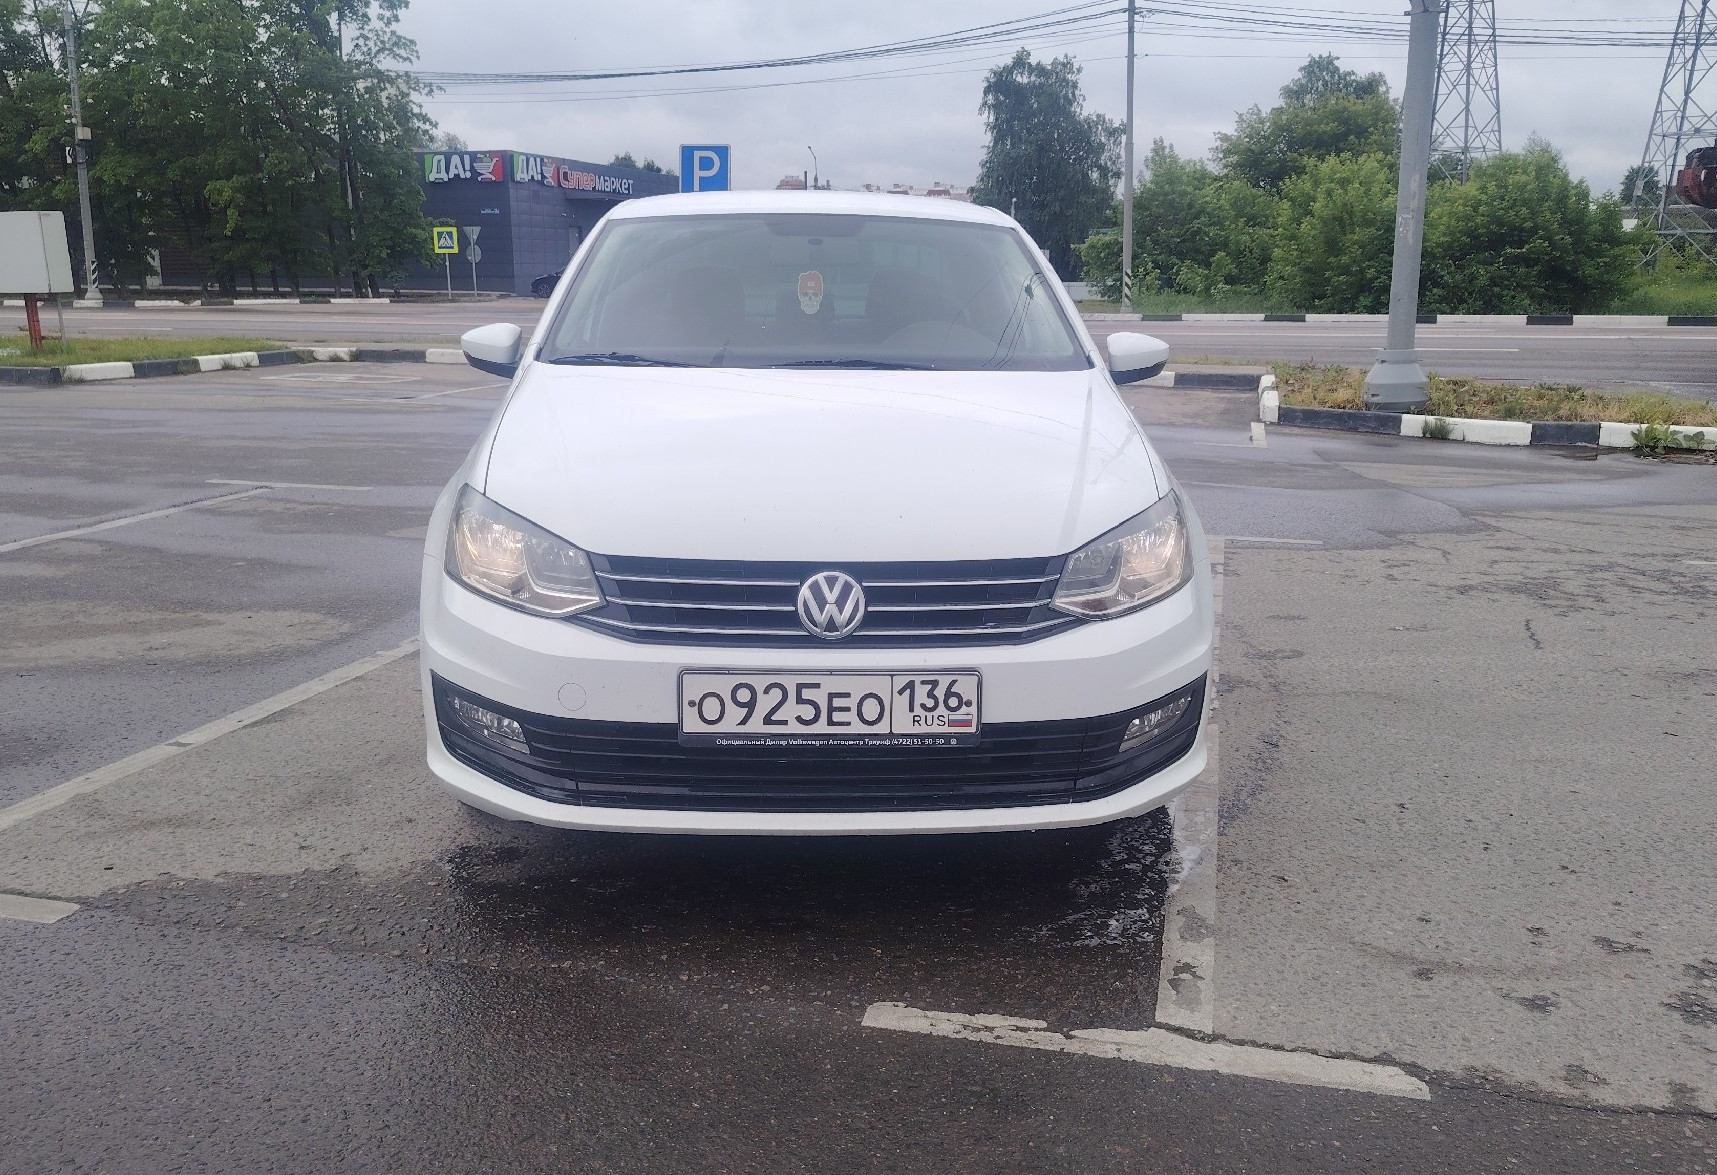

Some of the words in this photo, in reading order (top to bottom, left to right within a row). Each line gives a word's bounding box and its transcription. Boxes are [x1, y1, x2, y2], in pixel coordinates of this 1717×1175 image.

[429, 154, 471, 182] ДА!
[514, 155, 541, 182] ДА!
[559, 166, 634, 195] Супермаркет
[693, 150, 720, 191] P
[897, 680, 963, 713] 136
[912, 714, 946, 727] RUS
